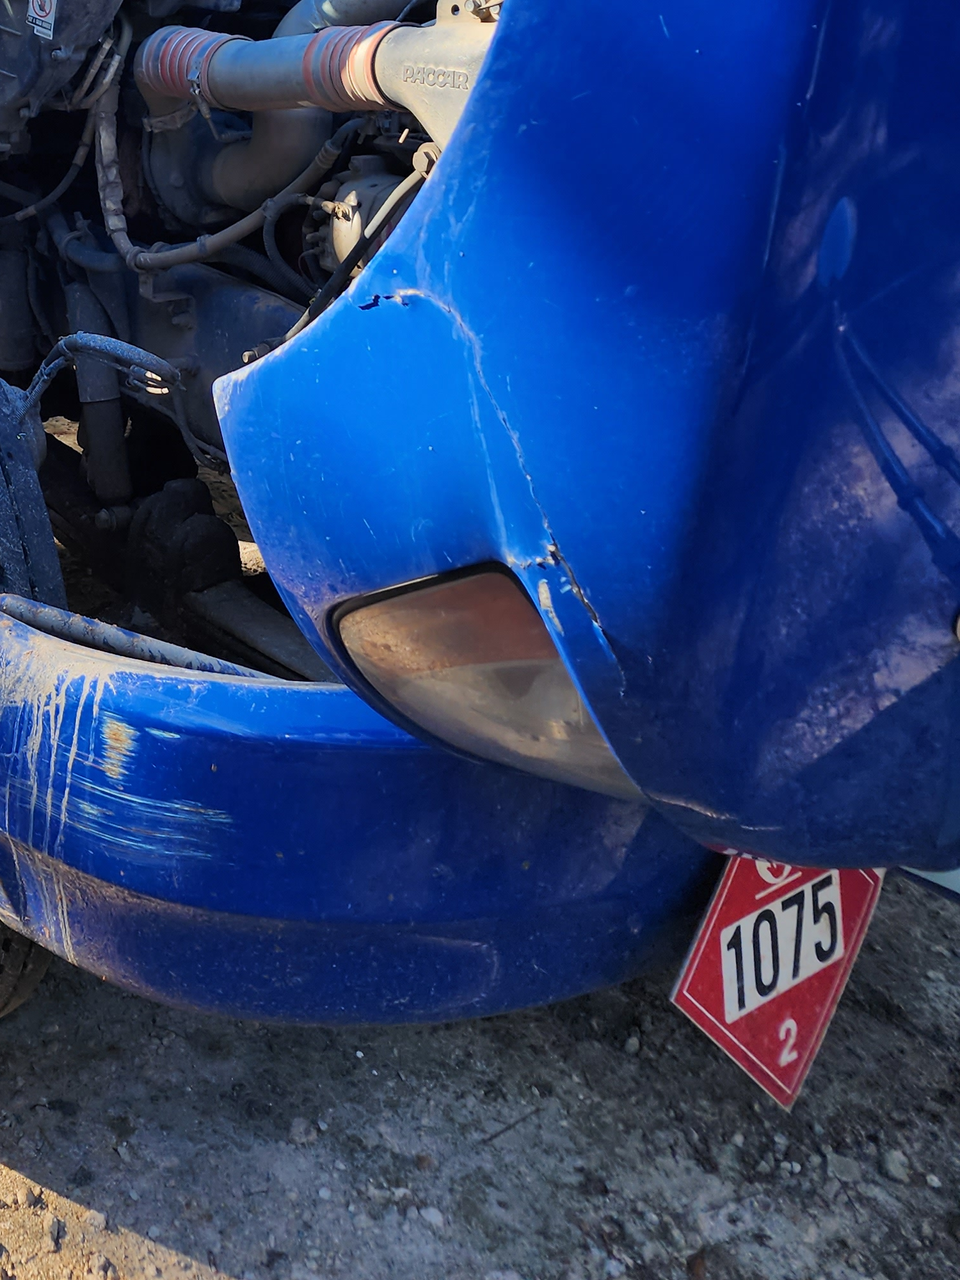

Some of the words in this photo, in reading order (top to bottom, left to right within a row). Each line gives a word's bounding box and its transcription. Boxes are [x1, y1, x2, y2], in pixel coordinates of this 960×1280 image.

[402, 64, 469, 90] PACCAR
[727, 874, 838, 1011] 1075
[778, 1018, 798, 1067] 2
